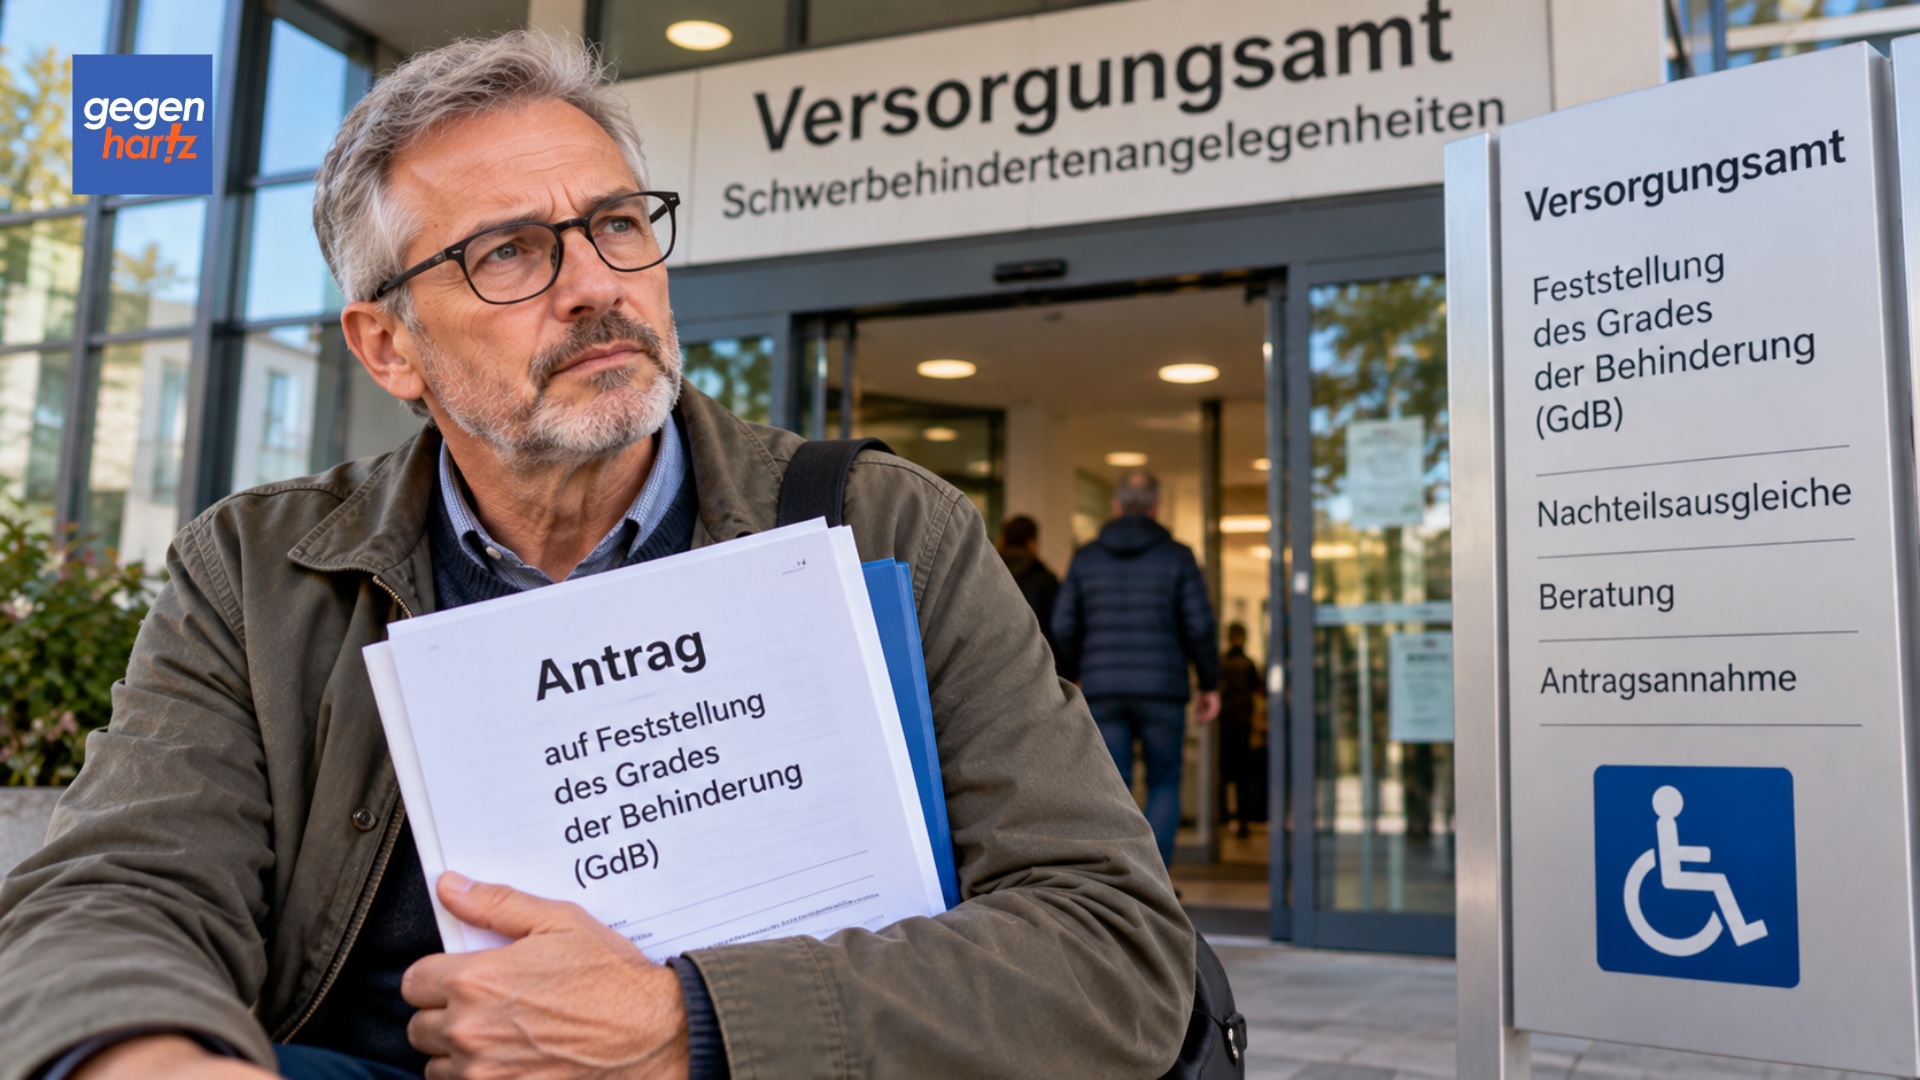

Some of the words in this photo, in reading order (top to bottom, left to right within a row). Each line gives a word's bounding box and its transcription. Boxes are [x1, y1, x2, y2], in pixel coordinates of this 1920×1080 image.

[753, 0, 1454, 154] Versorgungsamt
[721, 97, 1506, 220] Schwerbehindertenangelegenheiten
[1524, 129, 1847, 222] Versorgungsamt
[1532, 252, 1725, 305] Feststellung
[1533, 318, 1587, 348] des
[1596, 298, 1714, 337] Grades
[1534, 361, 1585, 391] der
[1595, 332, 1816, 383] Behinderung
[1535, 396, 1624, 440] (GdB)
[1537, 477, 1852, 528] Nachteilsausgleiche
[1539, 582, 1675, 612] Beratung
[535, 630, 707, 702] Antrag
[1539, 662, 1798, 700] Antragsannahme
[543, 731, 589, 767] auf
[595, 691, 767, 754] Feststellung
[553, 776, 608, 805] des
[614, 743, 721, 789] Grades
[563, 814, 613, 845] der
[619, 762, 804, 830] Behinderung
[573, 838, 660, 889] (GdB)
